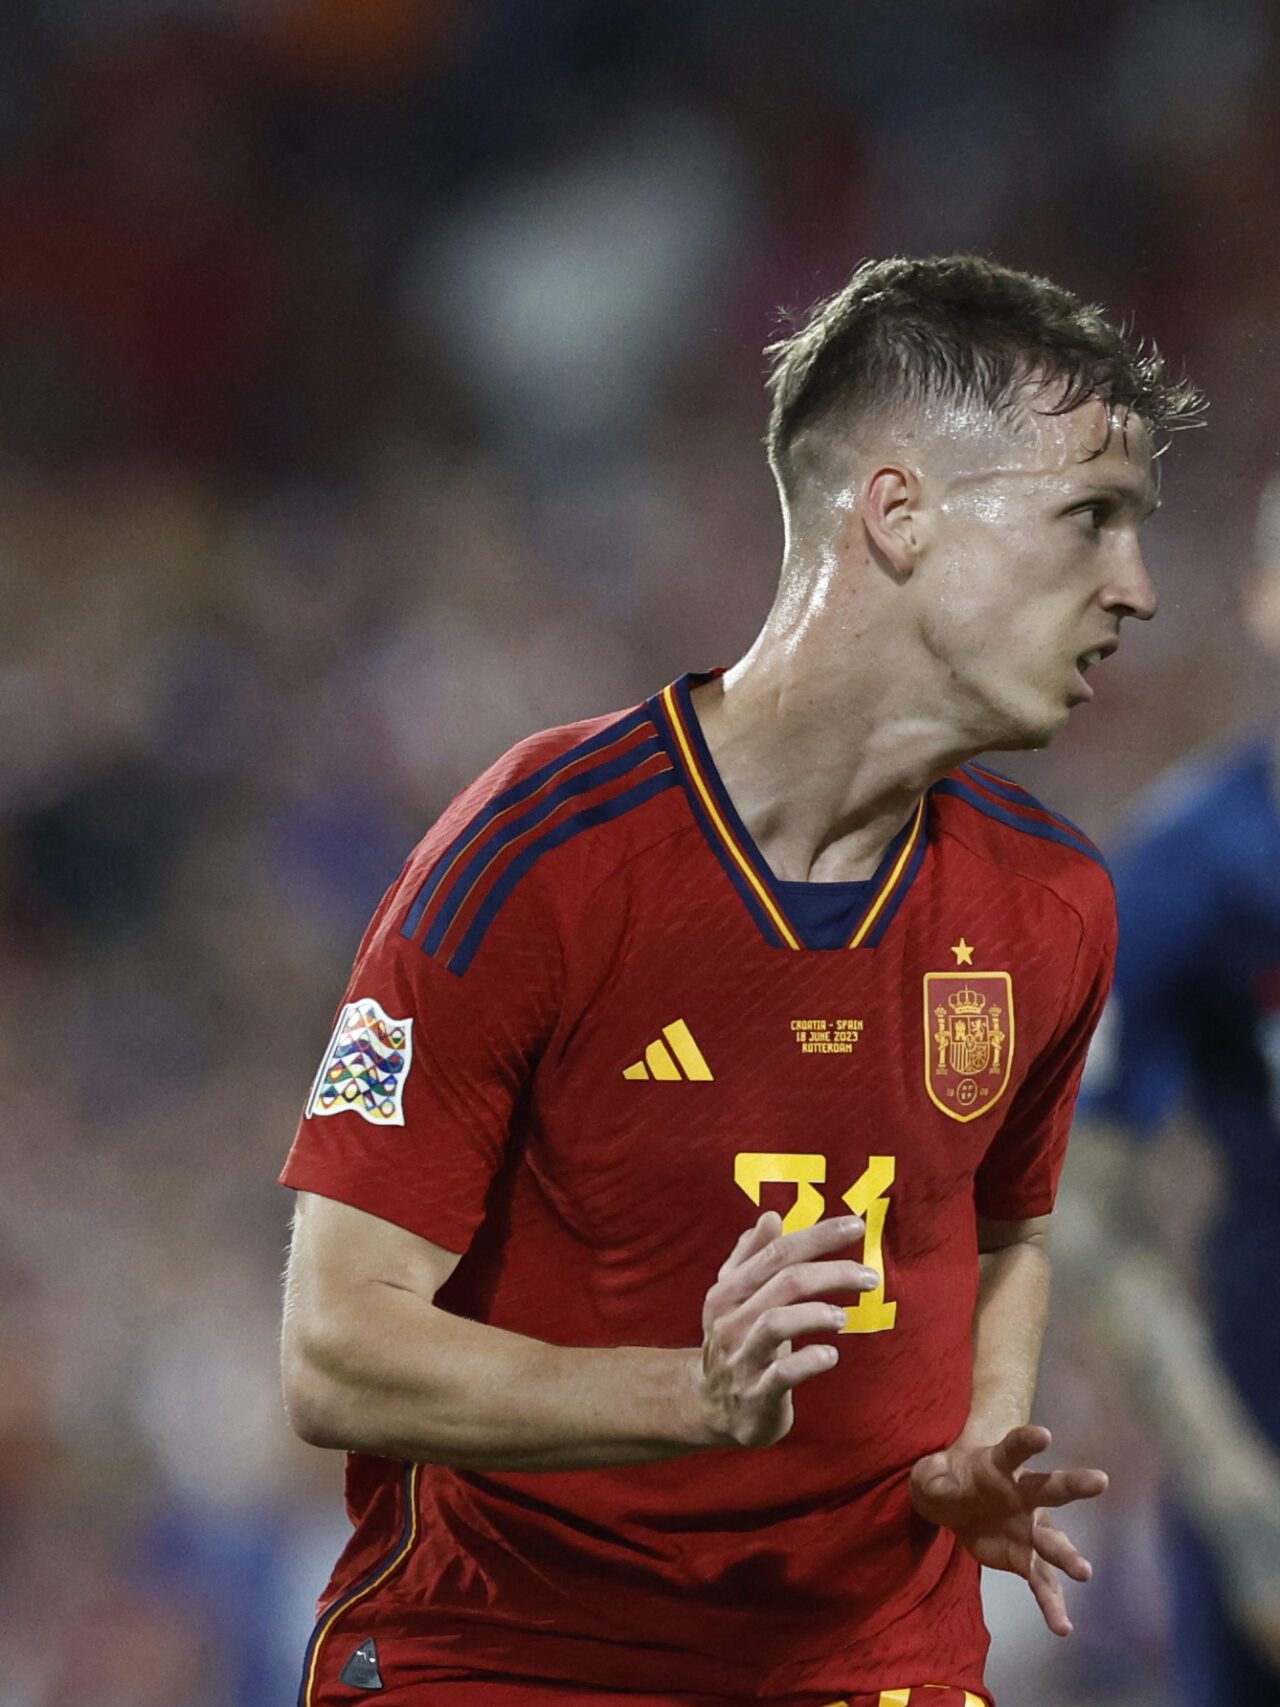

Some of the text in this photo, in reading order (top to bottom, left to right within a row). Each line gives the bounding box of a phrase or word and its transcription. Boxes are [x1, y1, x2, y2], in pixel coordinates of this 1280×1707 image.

[790, 1019, 827, 1031] CROATIA
[836, 1019, 864, 1031] SPAIN
[796, 1031, 859, 1042] 18 JUNE 2023
[802, 1042, 853, 1053] ROTTERDAM
